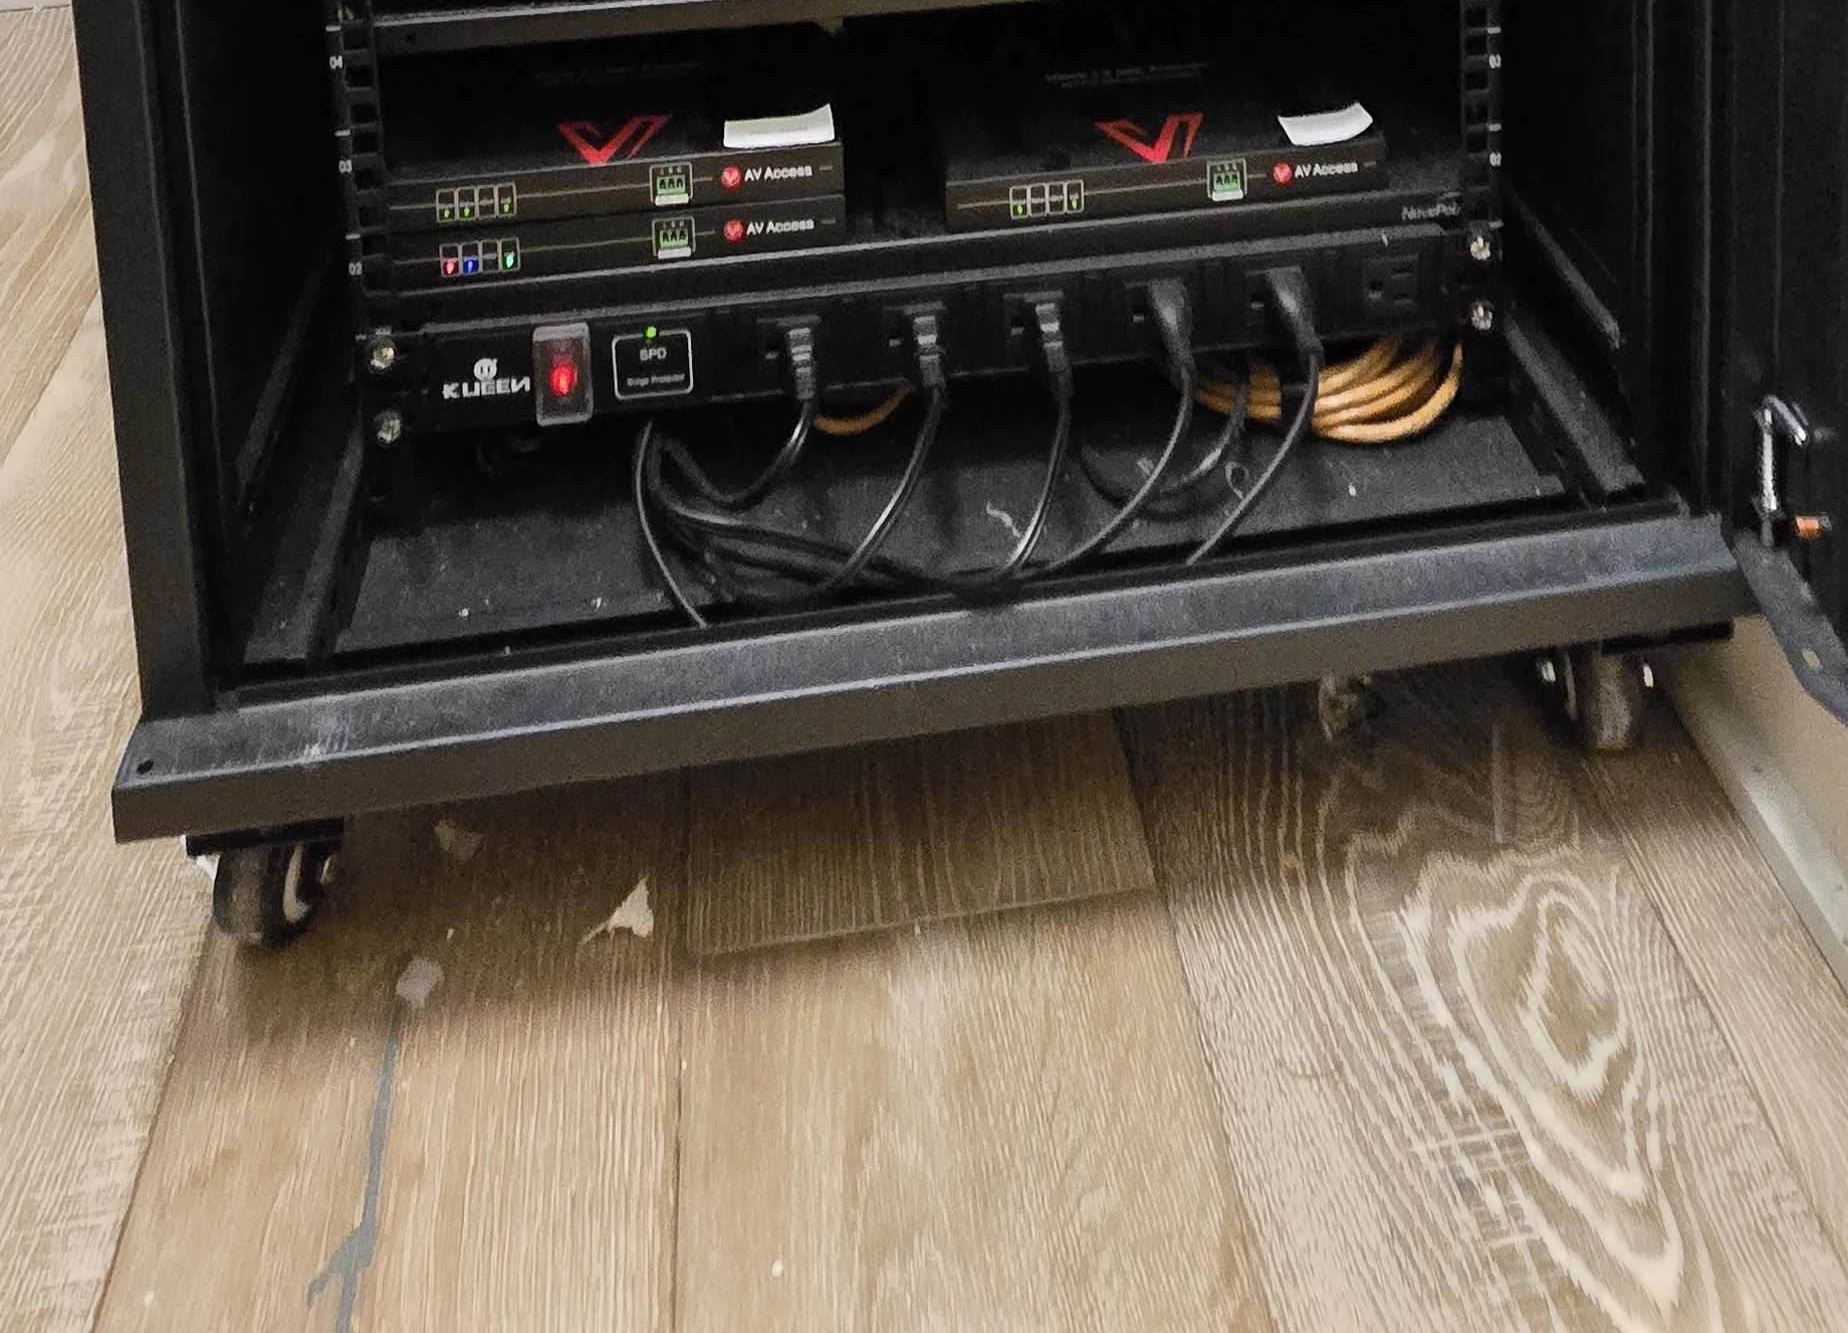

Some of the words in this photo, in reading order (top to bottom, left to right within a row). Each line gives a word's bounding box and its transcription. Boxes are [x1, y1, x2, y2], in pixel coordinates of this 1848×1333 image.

[329, 55, 343, 70] 04
[338, 159, 353, 174] 03
[744, 167, 762, 183] AV
[763, 165, 813, 181] Access
[1294, 164, 1312, 179] AV
[1312, 161, 1359, 177] Access
[746, 221, 765, 236] AV
[765, 218, 815, 234] Access
[348, 261, 363, 276] 02
[639, 346, 668, 362] SPD
[442, 376, 531, 400] KUEEN
